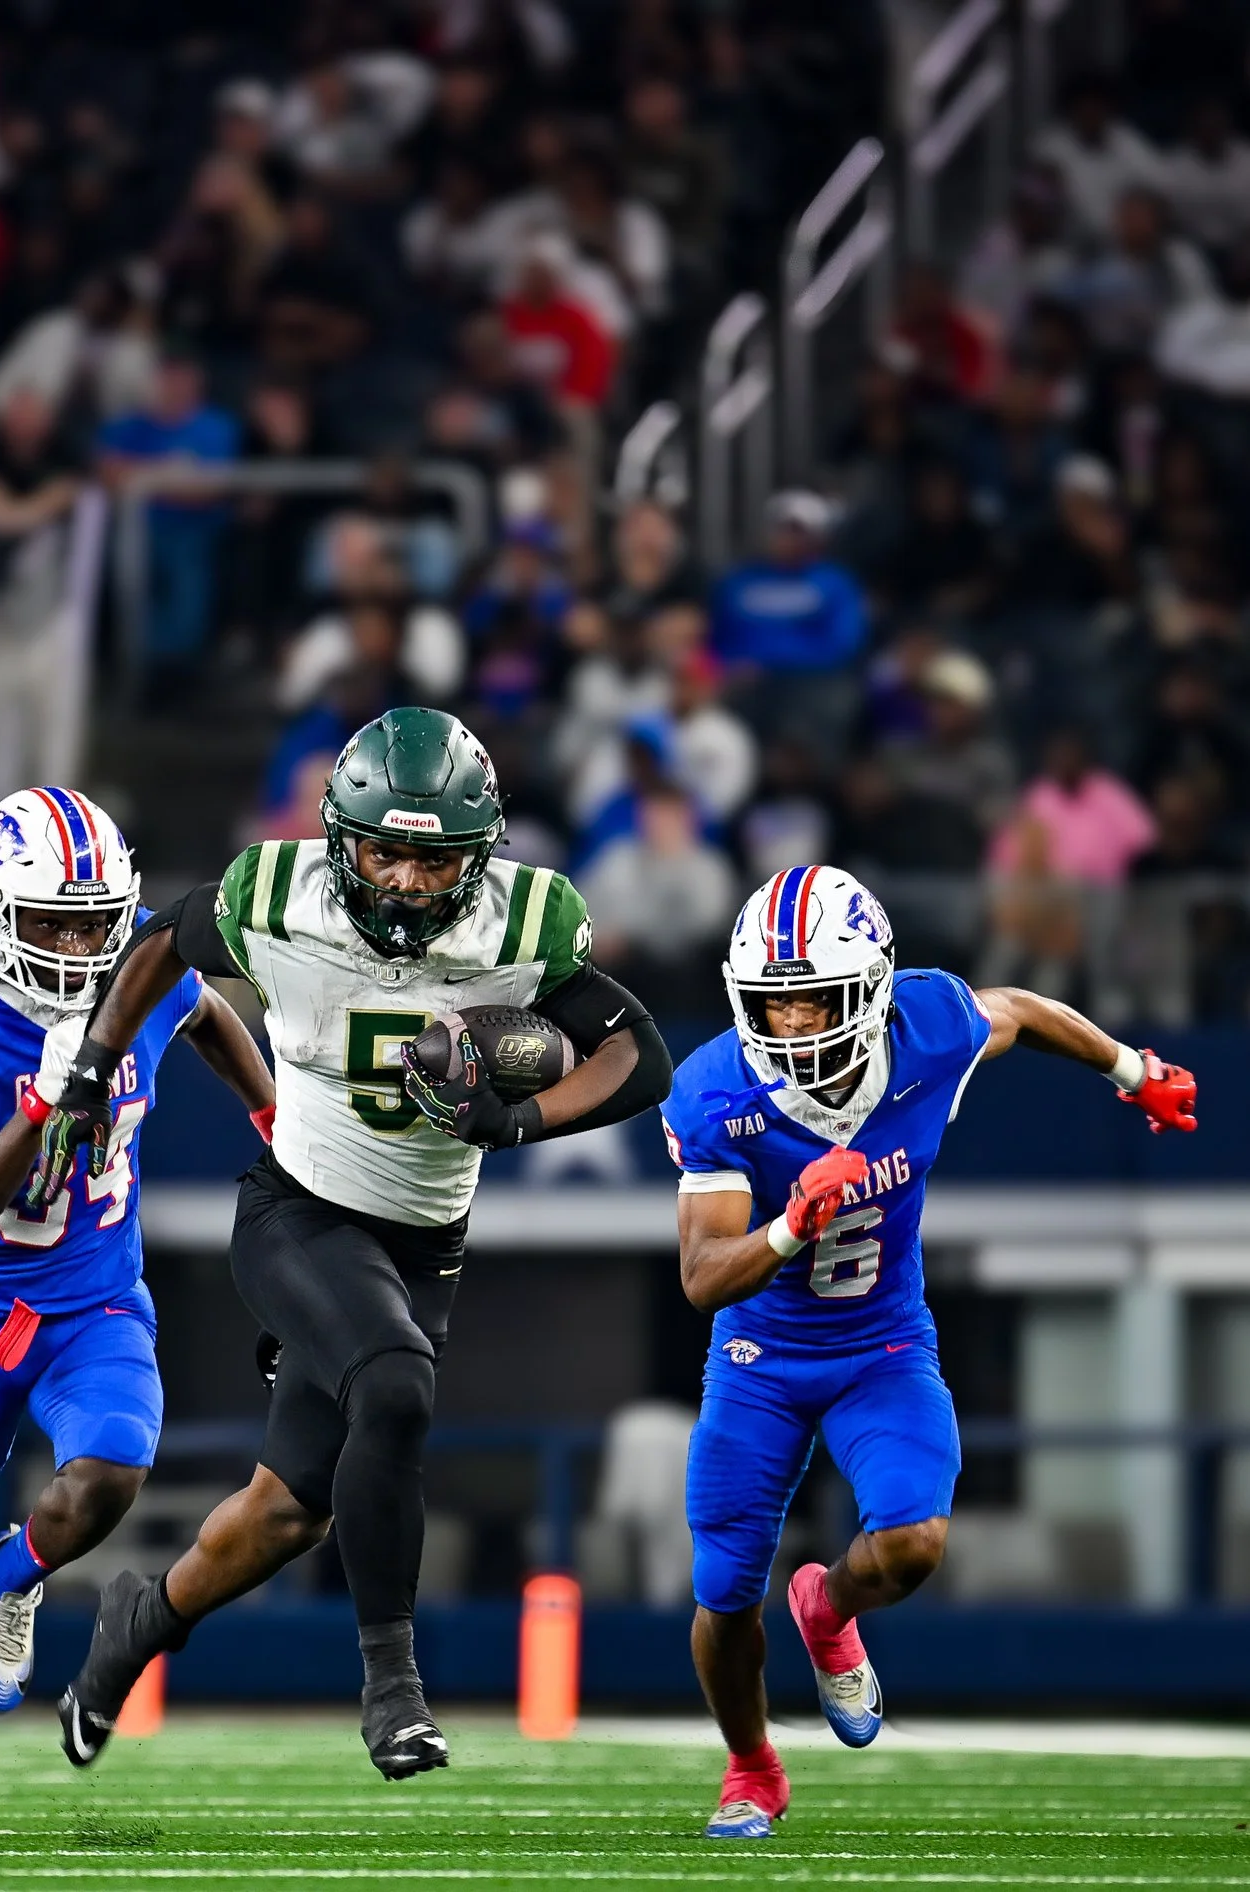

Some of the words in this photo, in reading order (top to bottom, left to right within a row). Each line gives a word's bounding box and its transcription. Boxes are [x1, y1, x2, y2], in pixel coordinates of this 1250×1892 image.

[390, 815, 435, 828] Riddell
[342, 1007, 435, 1139] 5
[724, 1112, 766, 1139] WAO
[808, 1206, 885, 1298] 6
